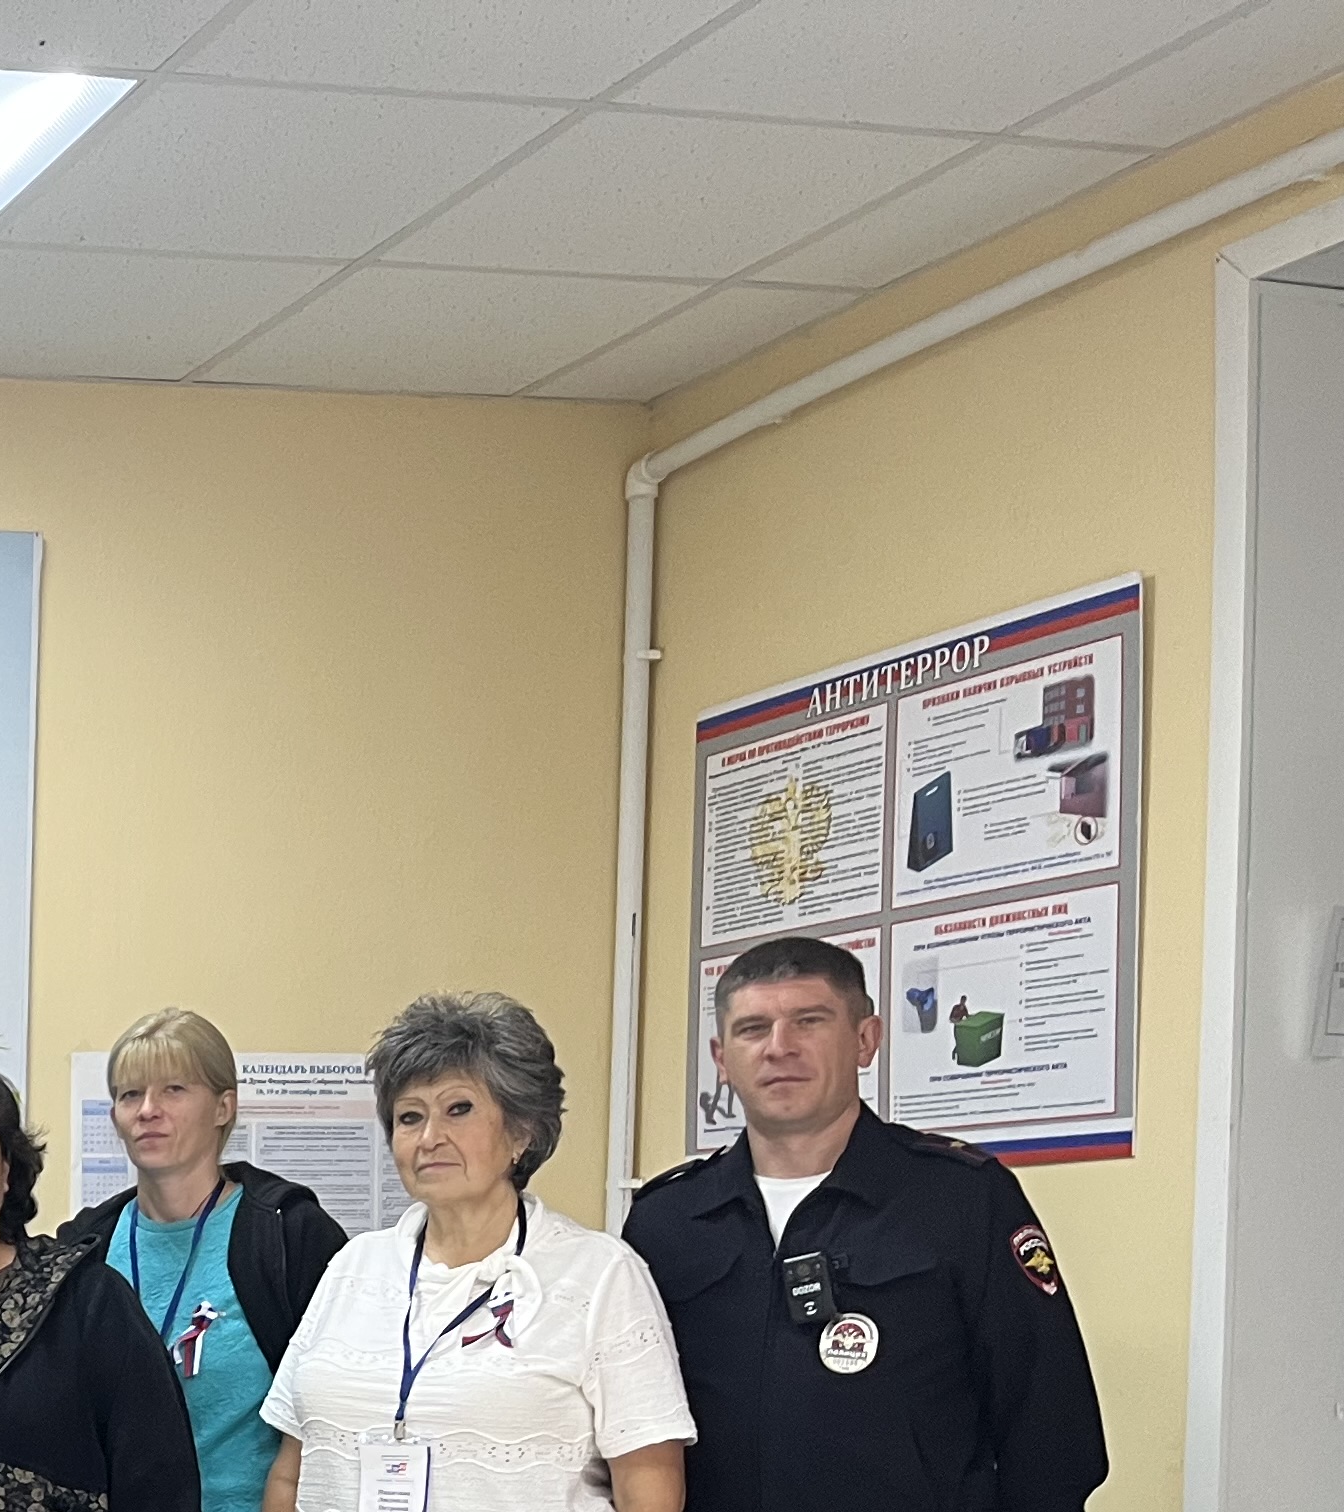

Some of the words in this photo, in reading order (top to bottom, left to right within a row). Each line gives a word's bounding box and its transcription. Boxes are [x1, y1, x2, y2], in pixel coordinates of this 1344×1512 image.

[806, 635, 990, 719] АНТИТЕРРОР
[242, 1064, 308, 1076] КАЛЕНДАРЬ
[309, 1065, 362, 1074] ВЫБОРОВ
